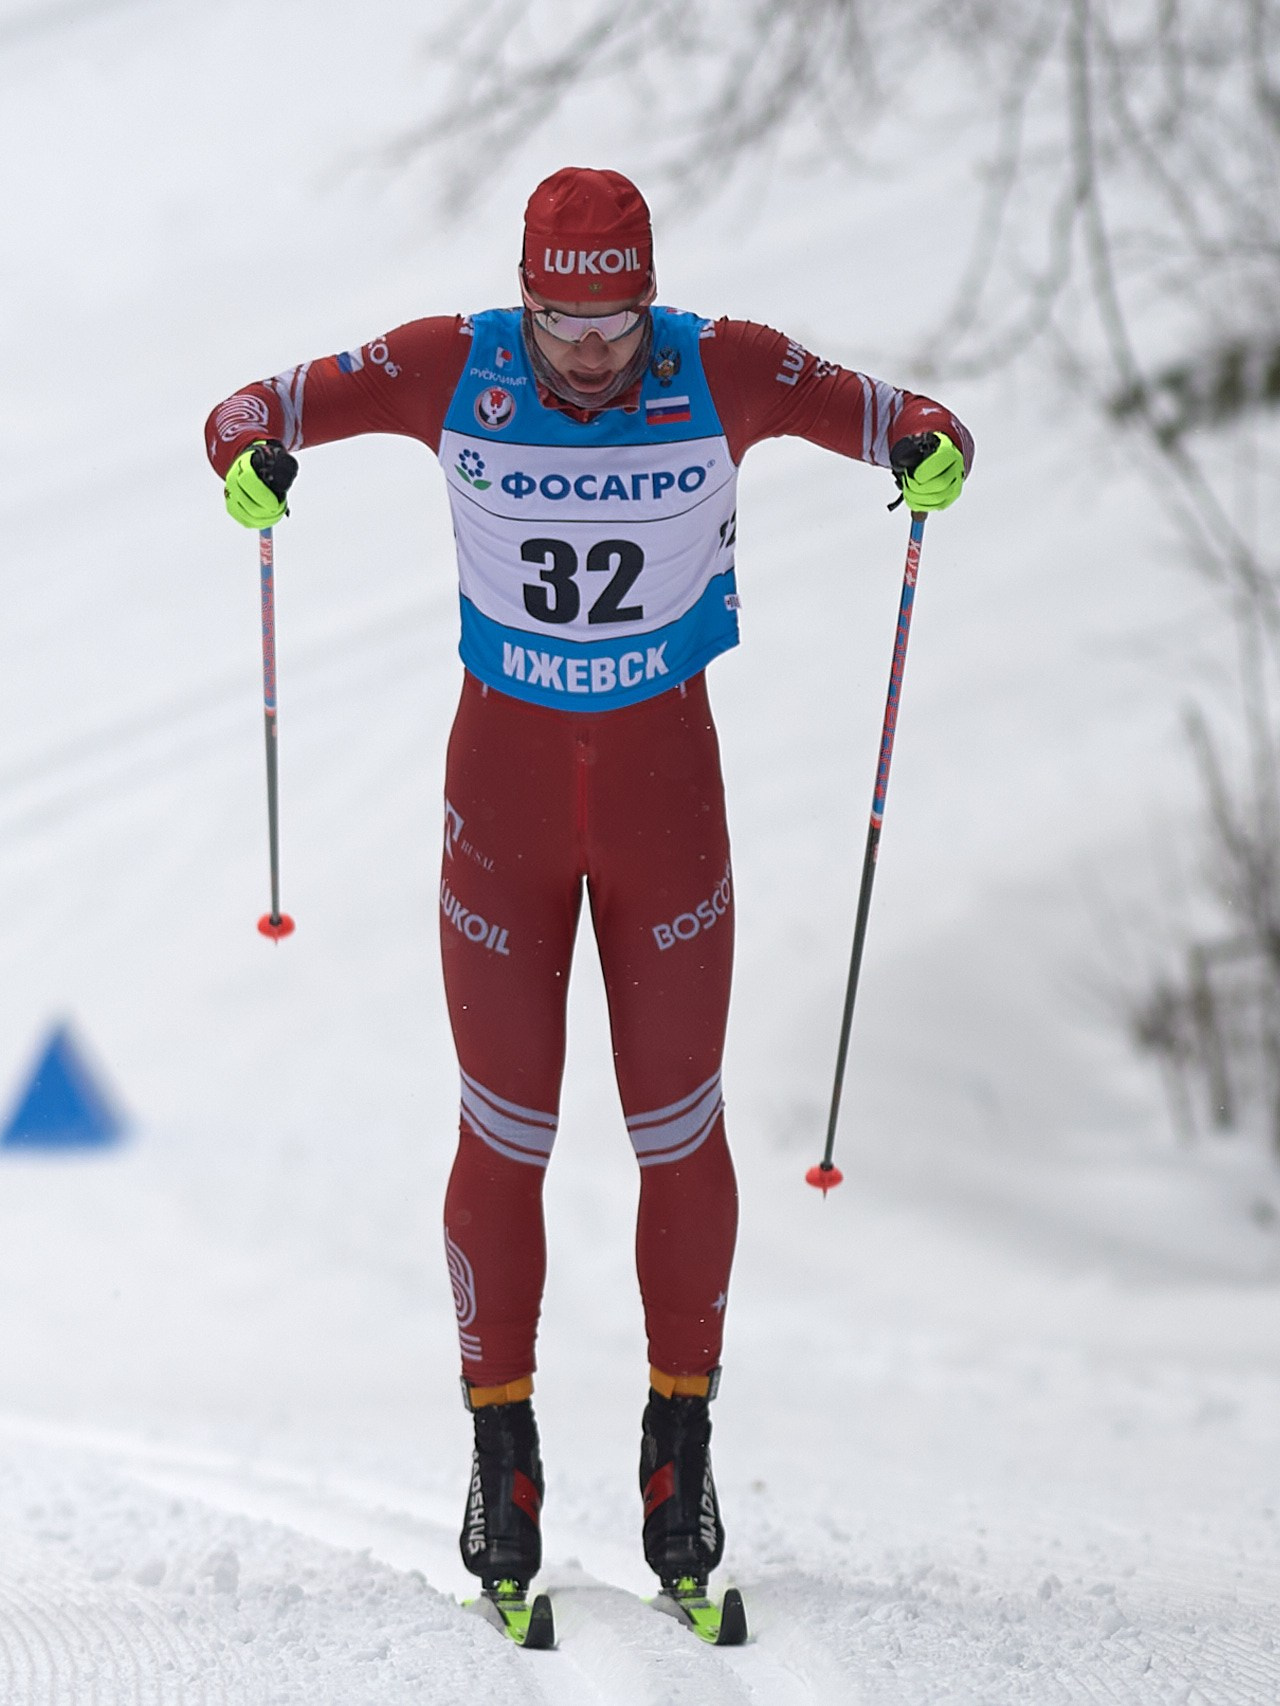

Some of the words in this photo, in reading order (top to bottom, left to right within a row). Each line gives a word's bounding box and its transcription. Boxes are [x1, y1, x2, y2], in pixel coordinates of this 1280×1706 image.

[544, 247, 641, 275] LUKOIL
[500, 465, 707, 501] ФОСАГРО
[520, 537, 645, 625] 32
[505, 639, 670, 694] ИЖЕВСК
